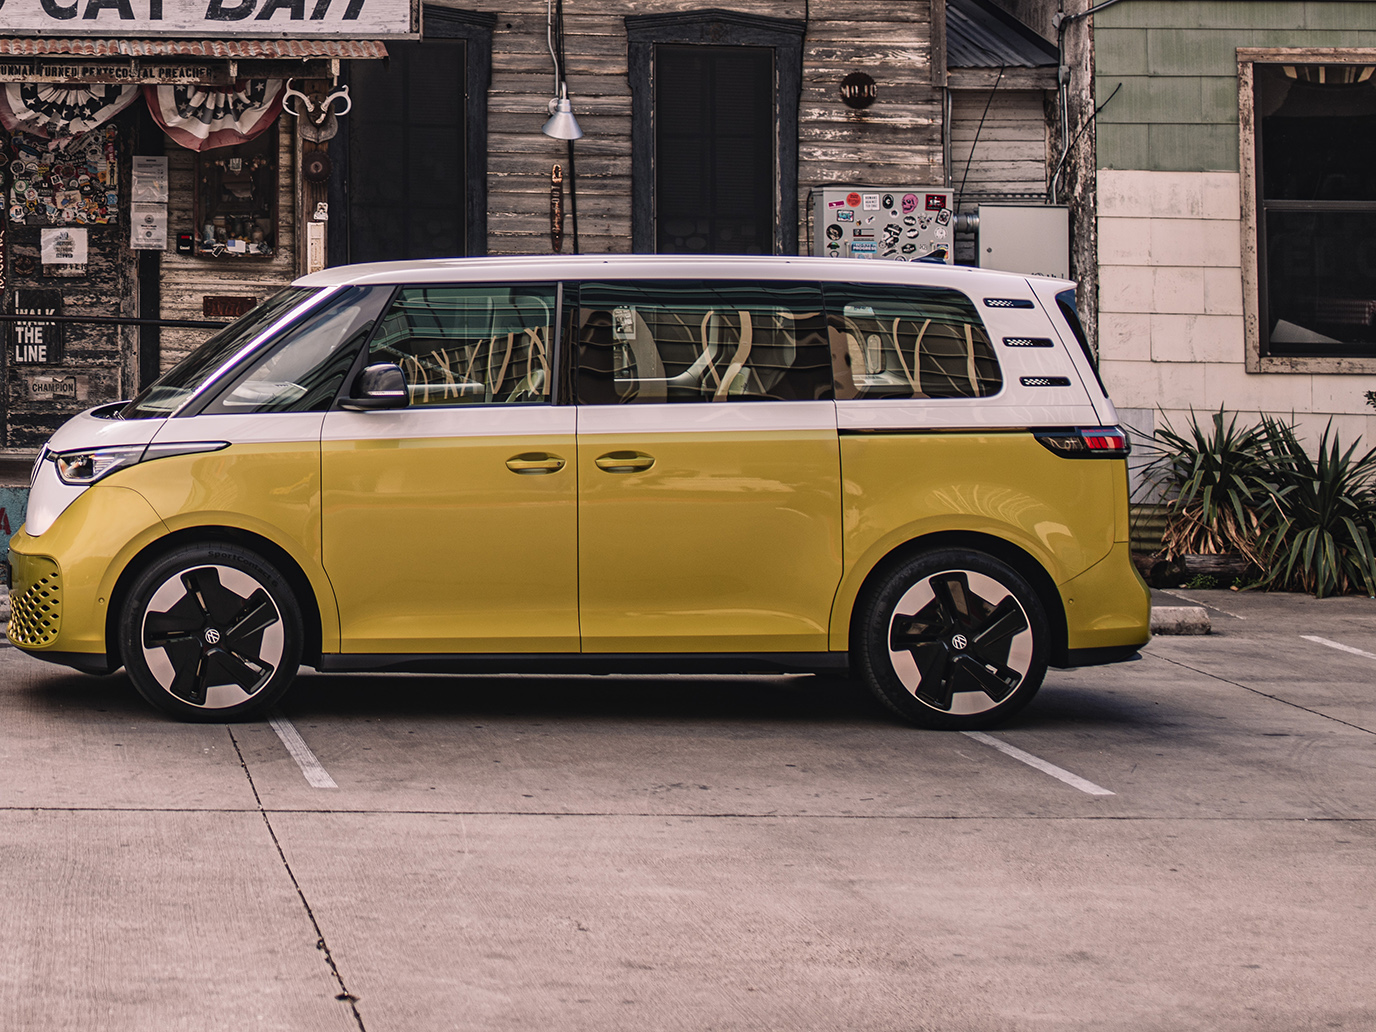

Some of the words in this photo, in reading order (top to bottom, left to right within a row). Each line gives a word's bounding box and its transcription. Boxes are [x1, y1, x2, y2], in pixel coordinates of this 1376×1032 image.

[14, 290, 20, 308] I
[15, 308, 56, 326] WALK
[15, 326, 43, 344] THE
[15, 345, 47, 362] LINE
[32, 382, 74, 393] CHAMPION
[207, 550, 272, 581] SportContact
